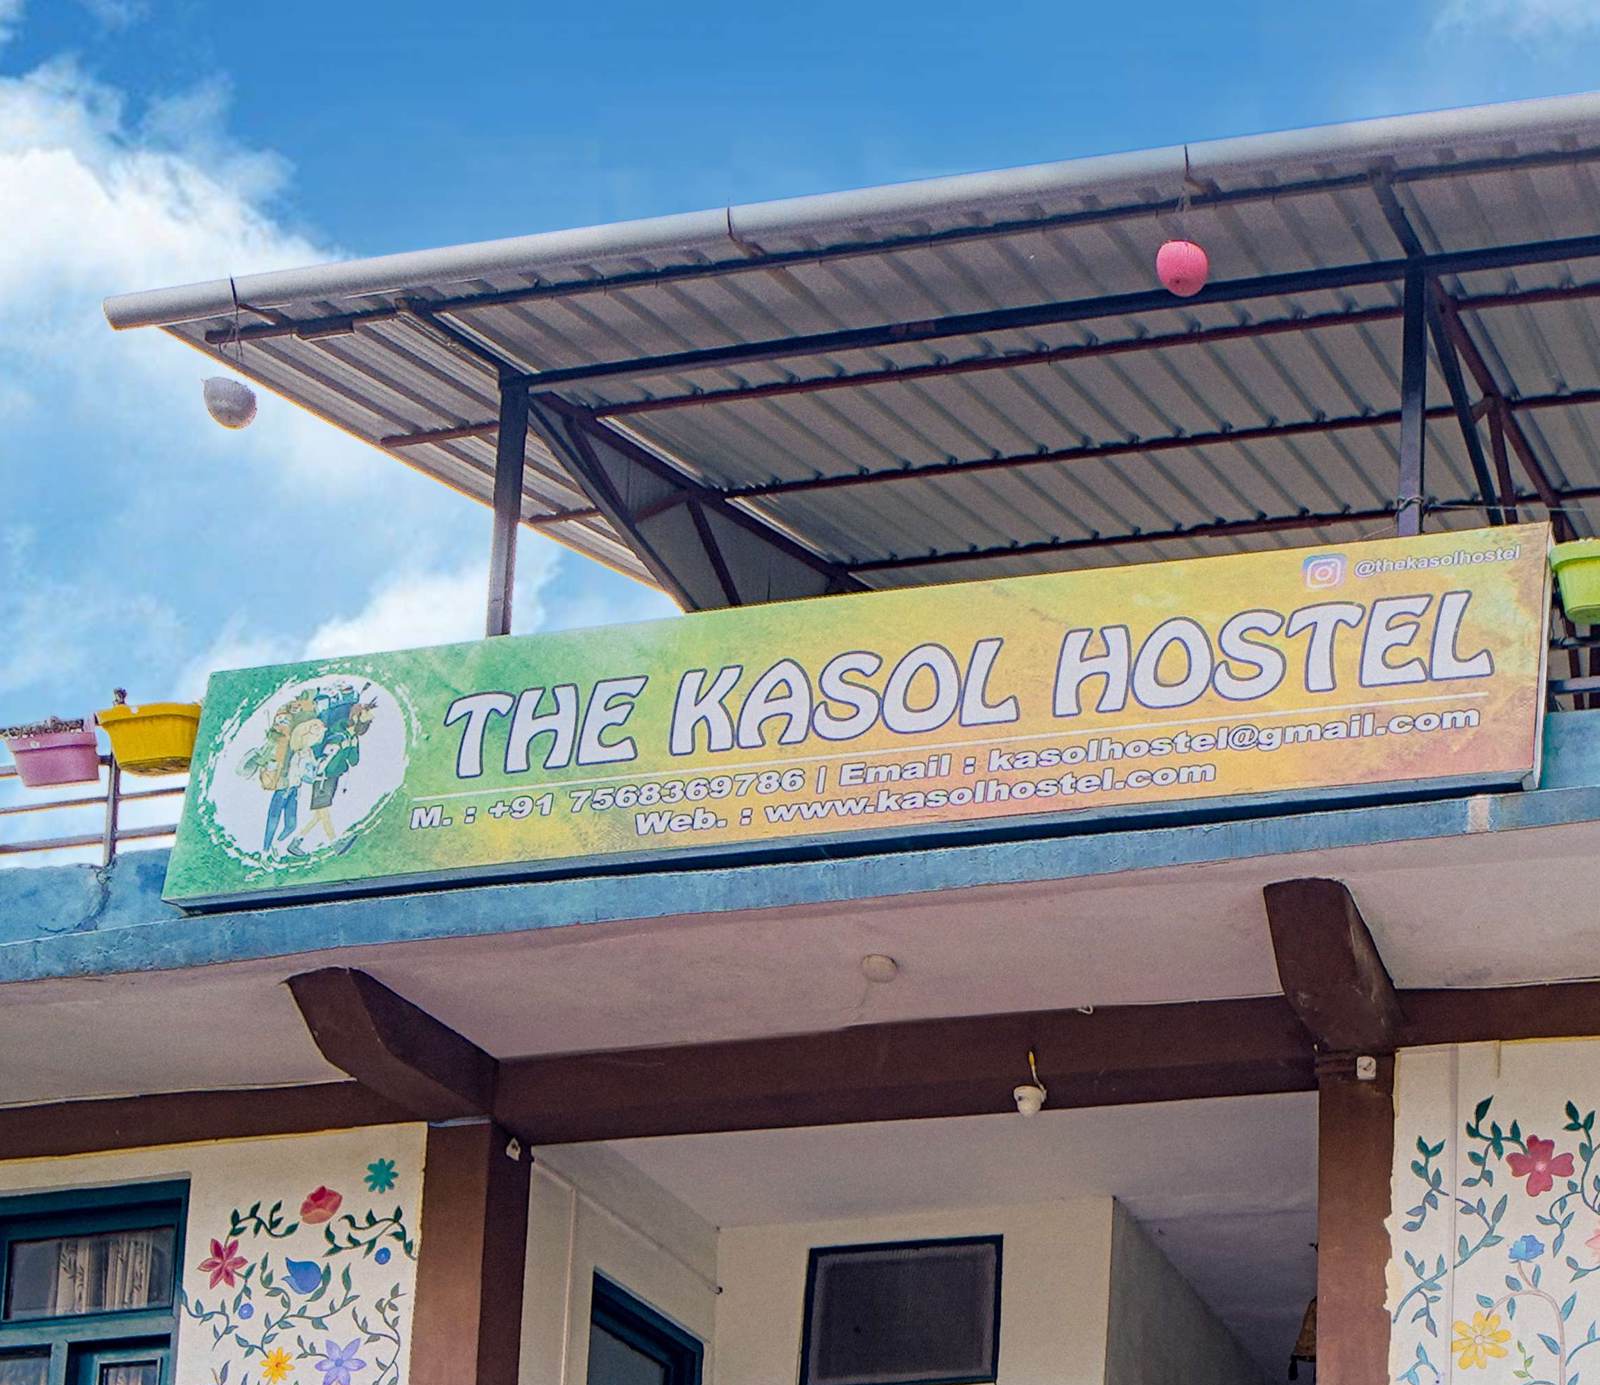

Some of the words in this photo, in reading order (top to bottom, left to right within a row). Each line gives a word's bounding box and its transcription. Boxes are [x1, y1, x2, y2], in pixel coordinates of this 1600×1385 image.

[1353, 544, 1521, 577] @thekasolhostel
[443, 674, 649, 779] THE
[668, 637, 1020, 757] KASOL
[1052, 590, 1495, 718] HOSTEL
[409, 805, 453, 829] M.
[488, 793, 554, 819] +91
[569, 767, 805, 813] 7568369786
[839, 753, 952, 787] Email
[988, 708, 1481, 772] kasolhostel@gmail.com
[634, 807, 727, 836] Web.
[764, 763, 1217, 823] www.kasolhostel.com
